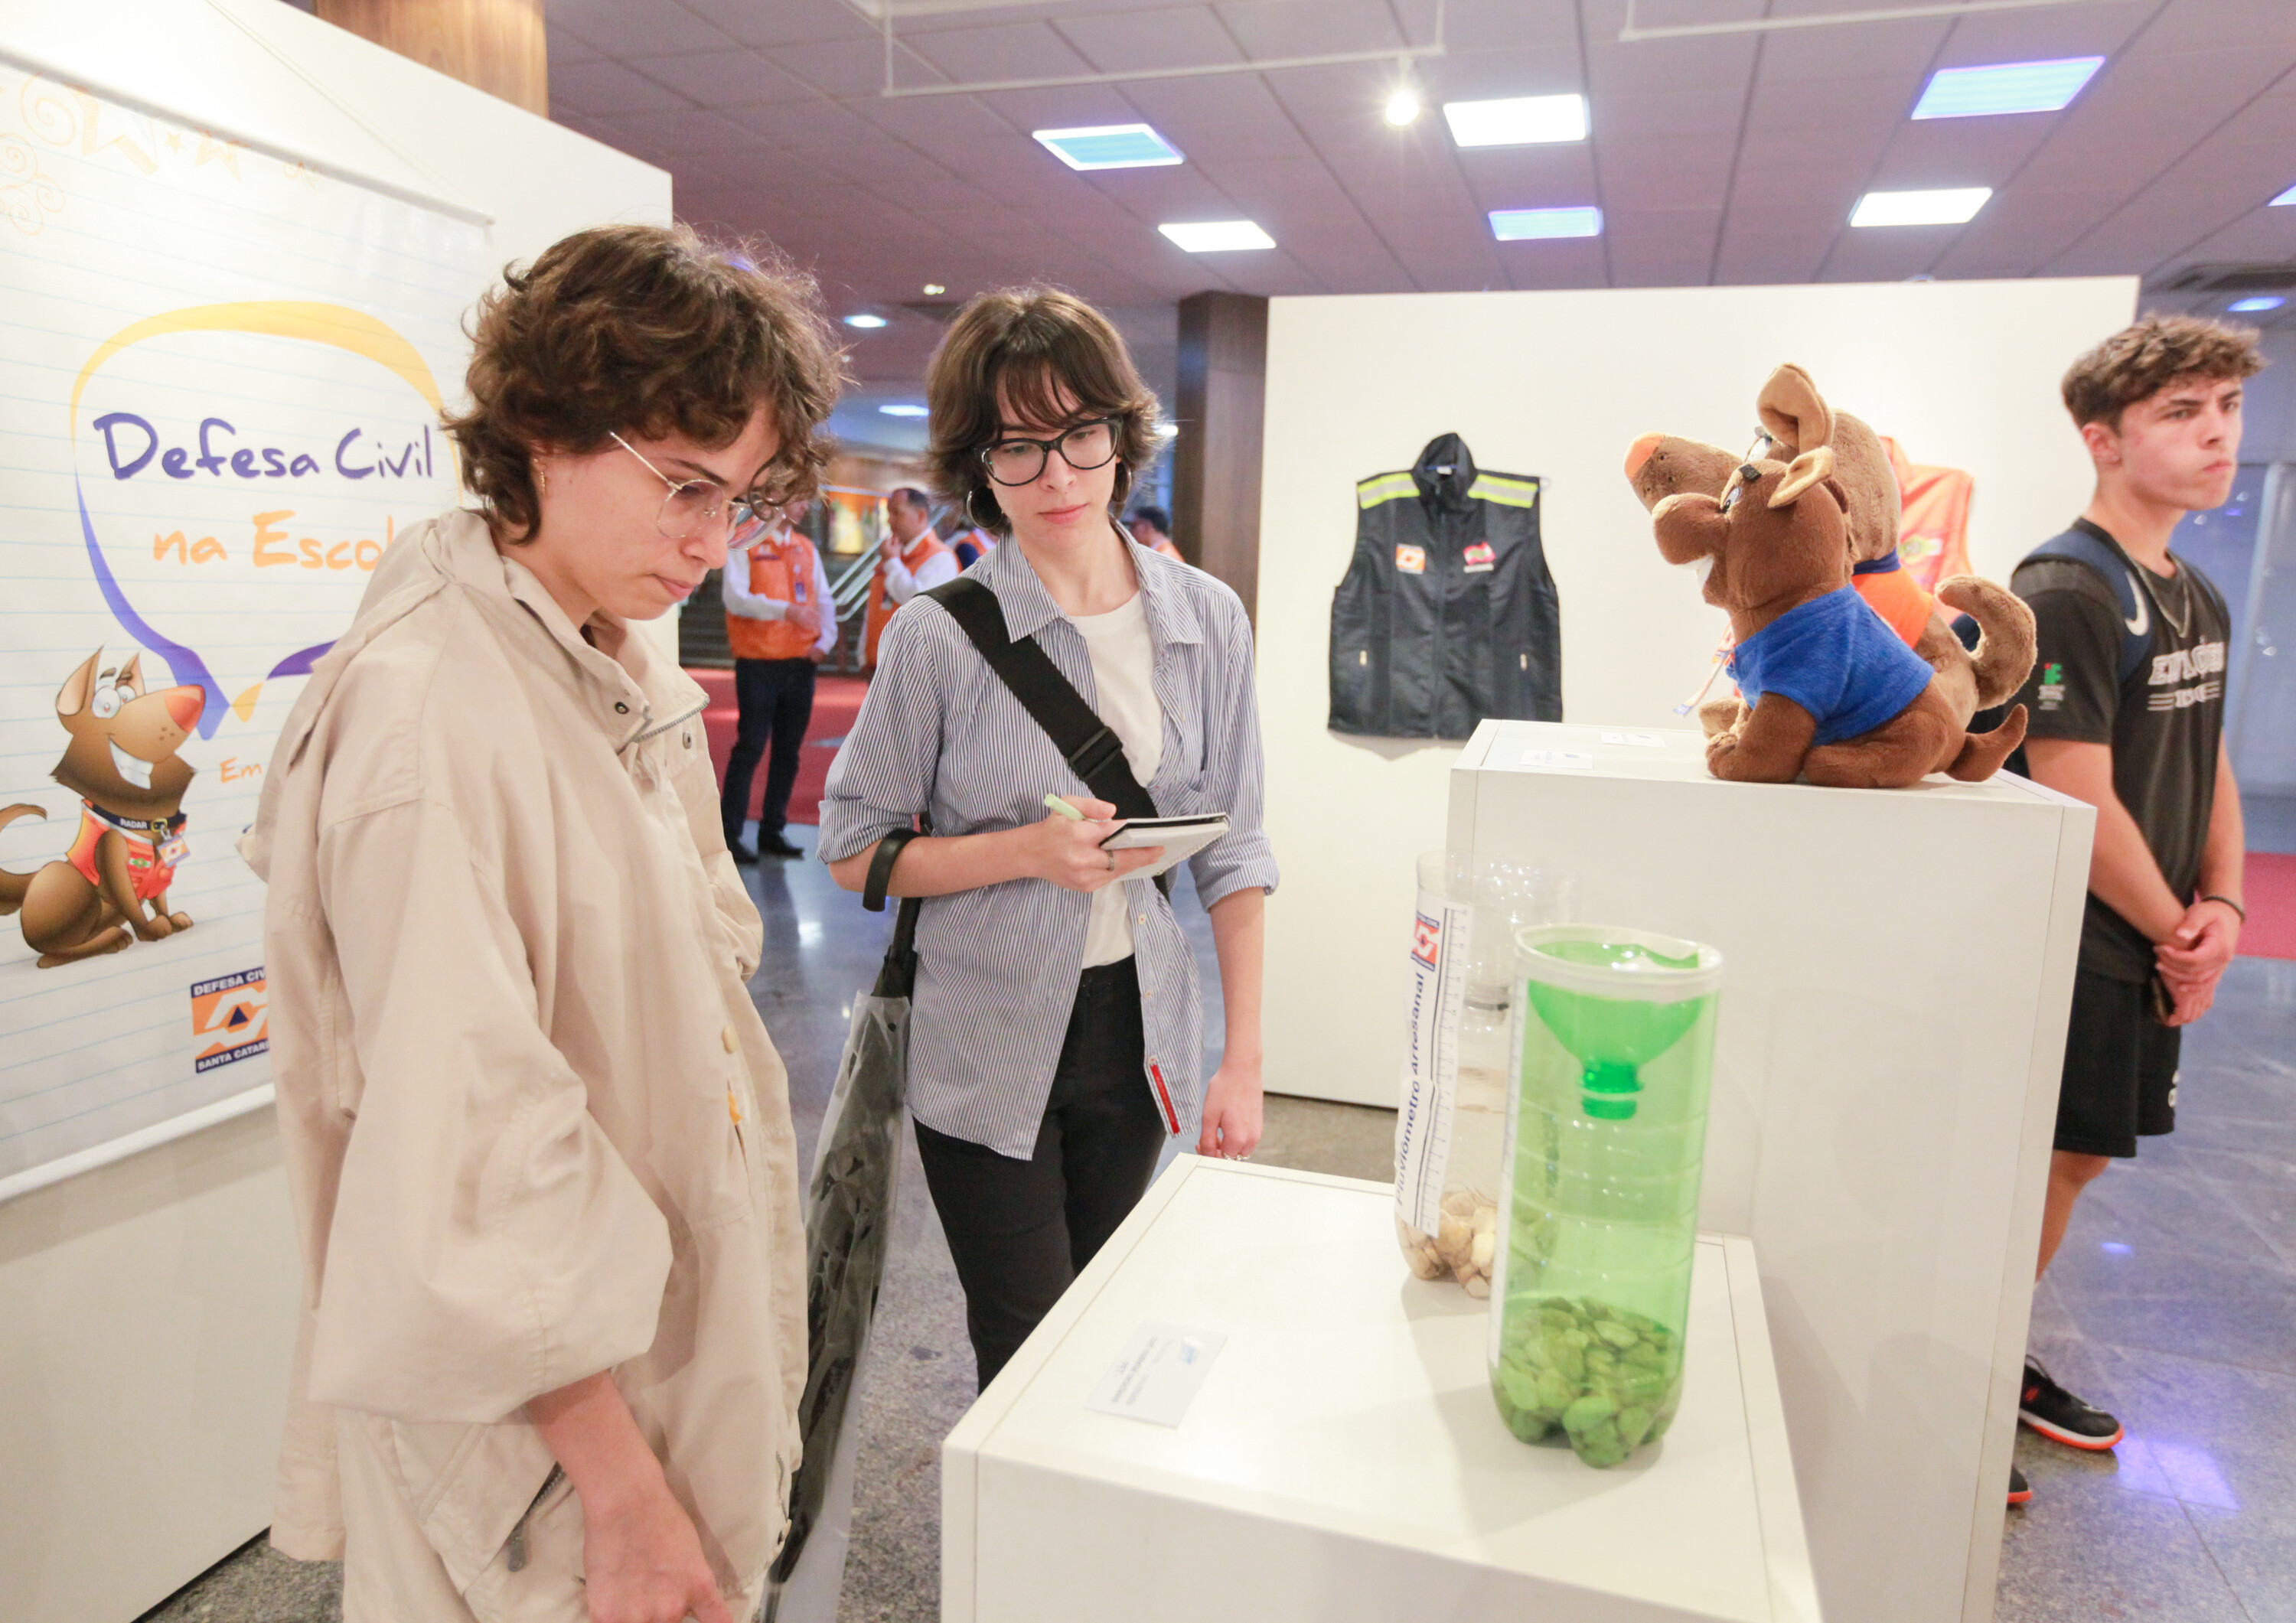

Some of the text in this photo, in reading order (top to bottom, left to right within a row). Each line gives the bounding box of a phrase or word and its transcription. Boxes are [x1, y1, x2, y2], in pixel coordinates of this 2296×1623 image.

[93, 412, 433, 481] Defesa Civil
[153, 509, 394, 572] na Escol
[219, 757, 263, 784] Em
[119, 817, 148, 829] RADAR
[193, 969, 266, 996] DEFESA CIV
[197, 1040, 269, 1071] SANTA CATARI
